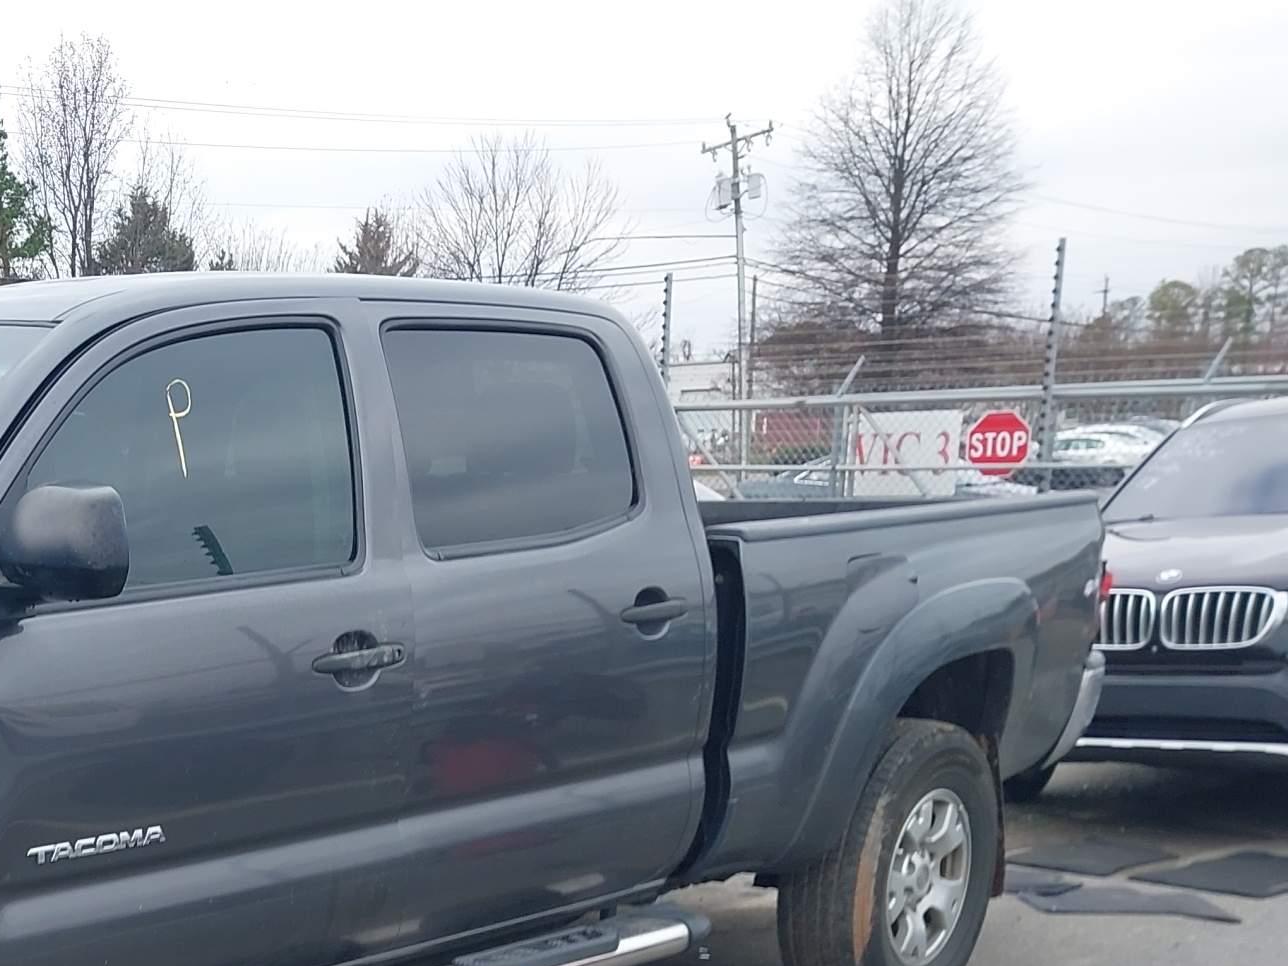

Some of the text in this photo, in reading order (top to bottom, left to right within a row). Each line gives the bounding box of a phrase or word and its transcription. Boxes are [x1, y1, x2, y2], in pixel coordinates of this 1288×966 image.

[933, 429, 952, 476] 3
[970, 430, 1027, 459] STOP
[26, 824, 167, 865] TACOMA
